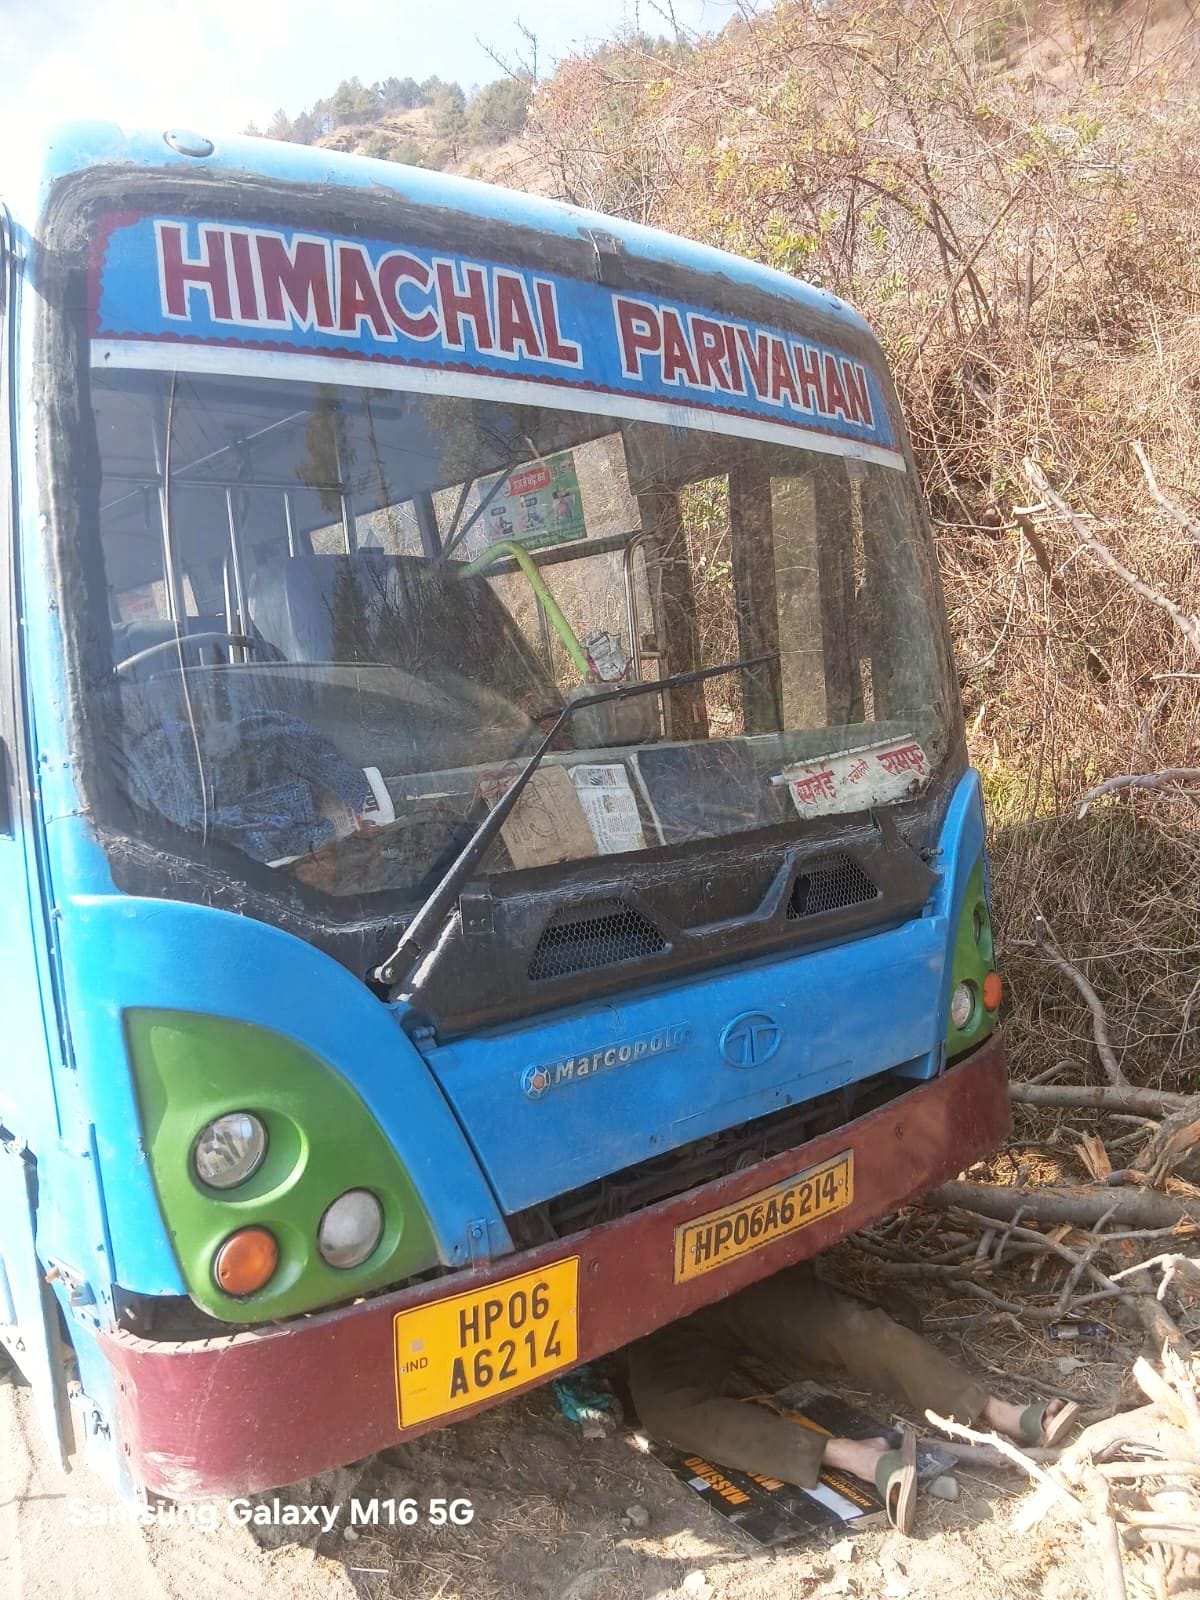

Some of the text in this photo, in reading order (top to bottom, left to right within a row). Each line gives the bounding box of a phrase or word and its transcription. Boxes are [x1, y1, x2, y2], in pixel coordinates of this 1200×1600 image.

[153, 218, 876, 430] HIMACHAL PARIVAHAN
[554, 1024, 693, 1084] Marcopolo
[693, 1171, 839, 1266] HP06A6214
[458, 1282, 550, 1349] HP06
[405, 1357, 428, 1373] IND
[449, 1319, 562, 1399] A6214
